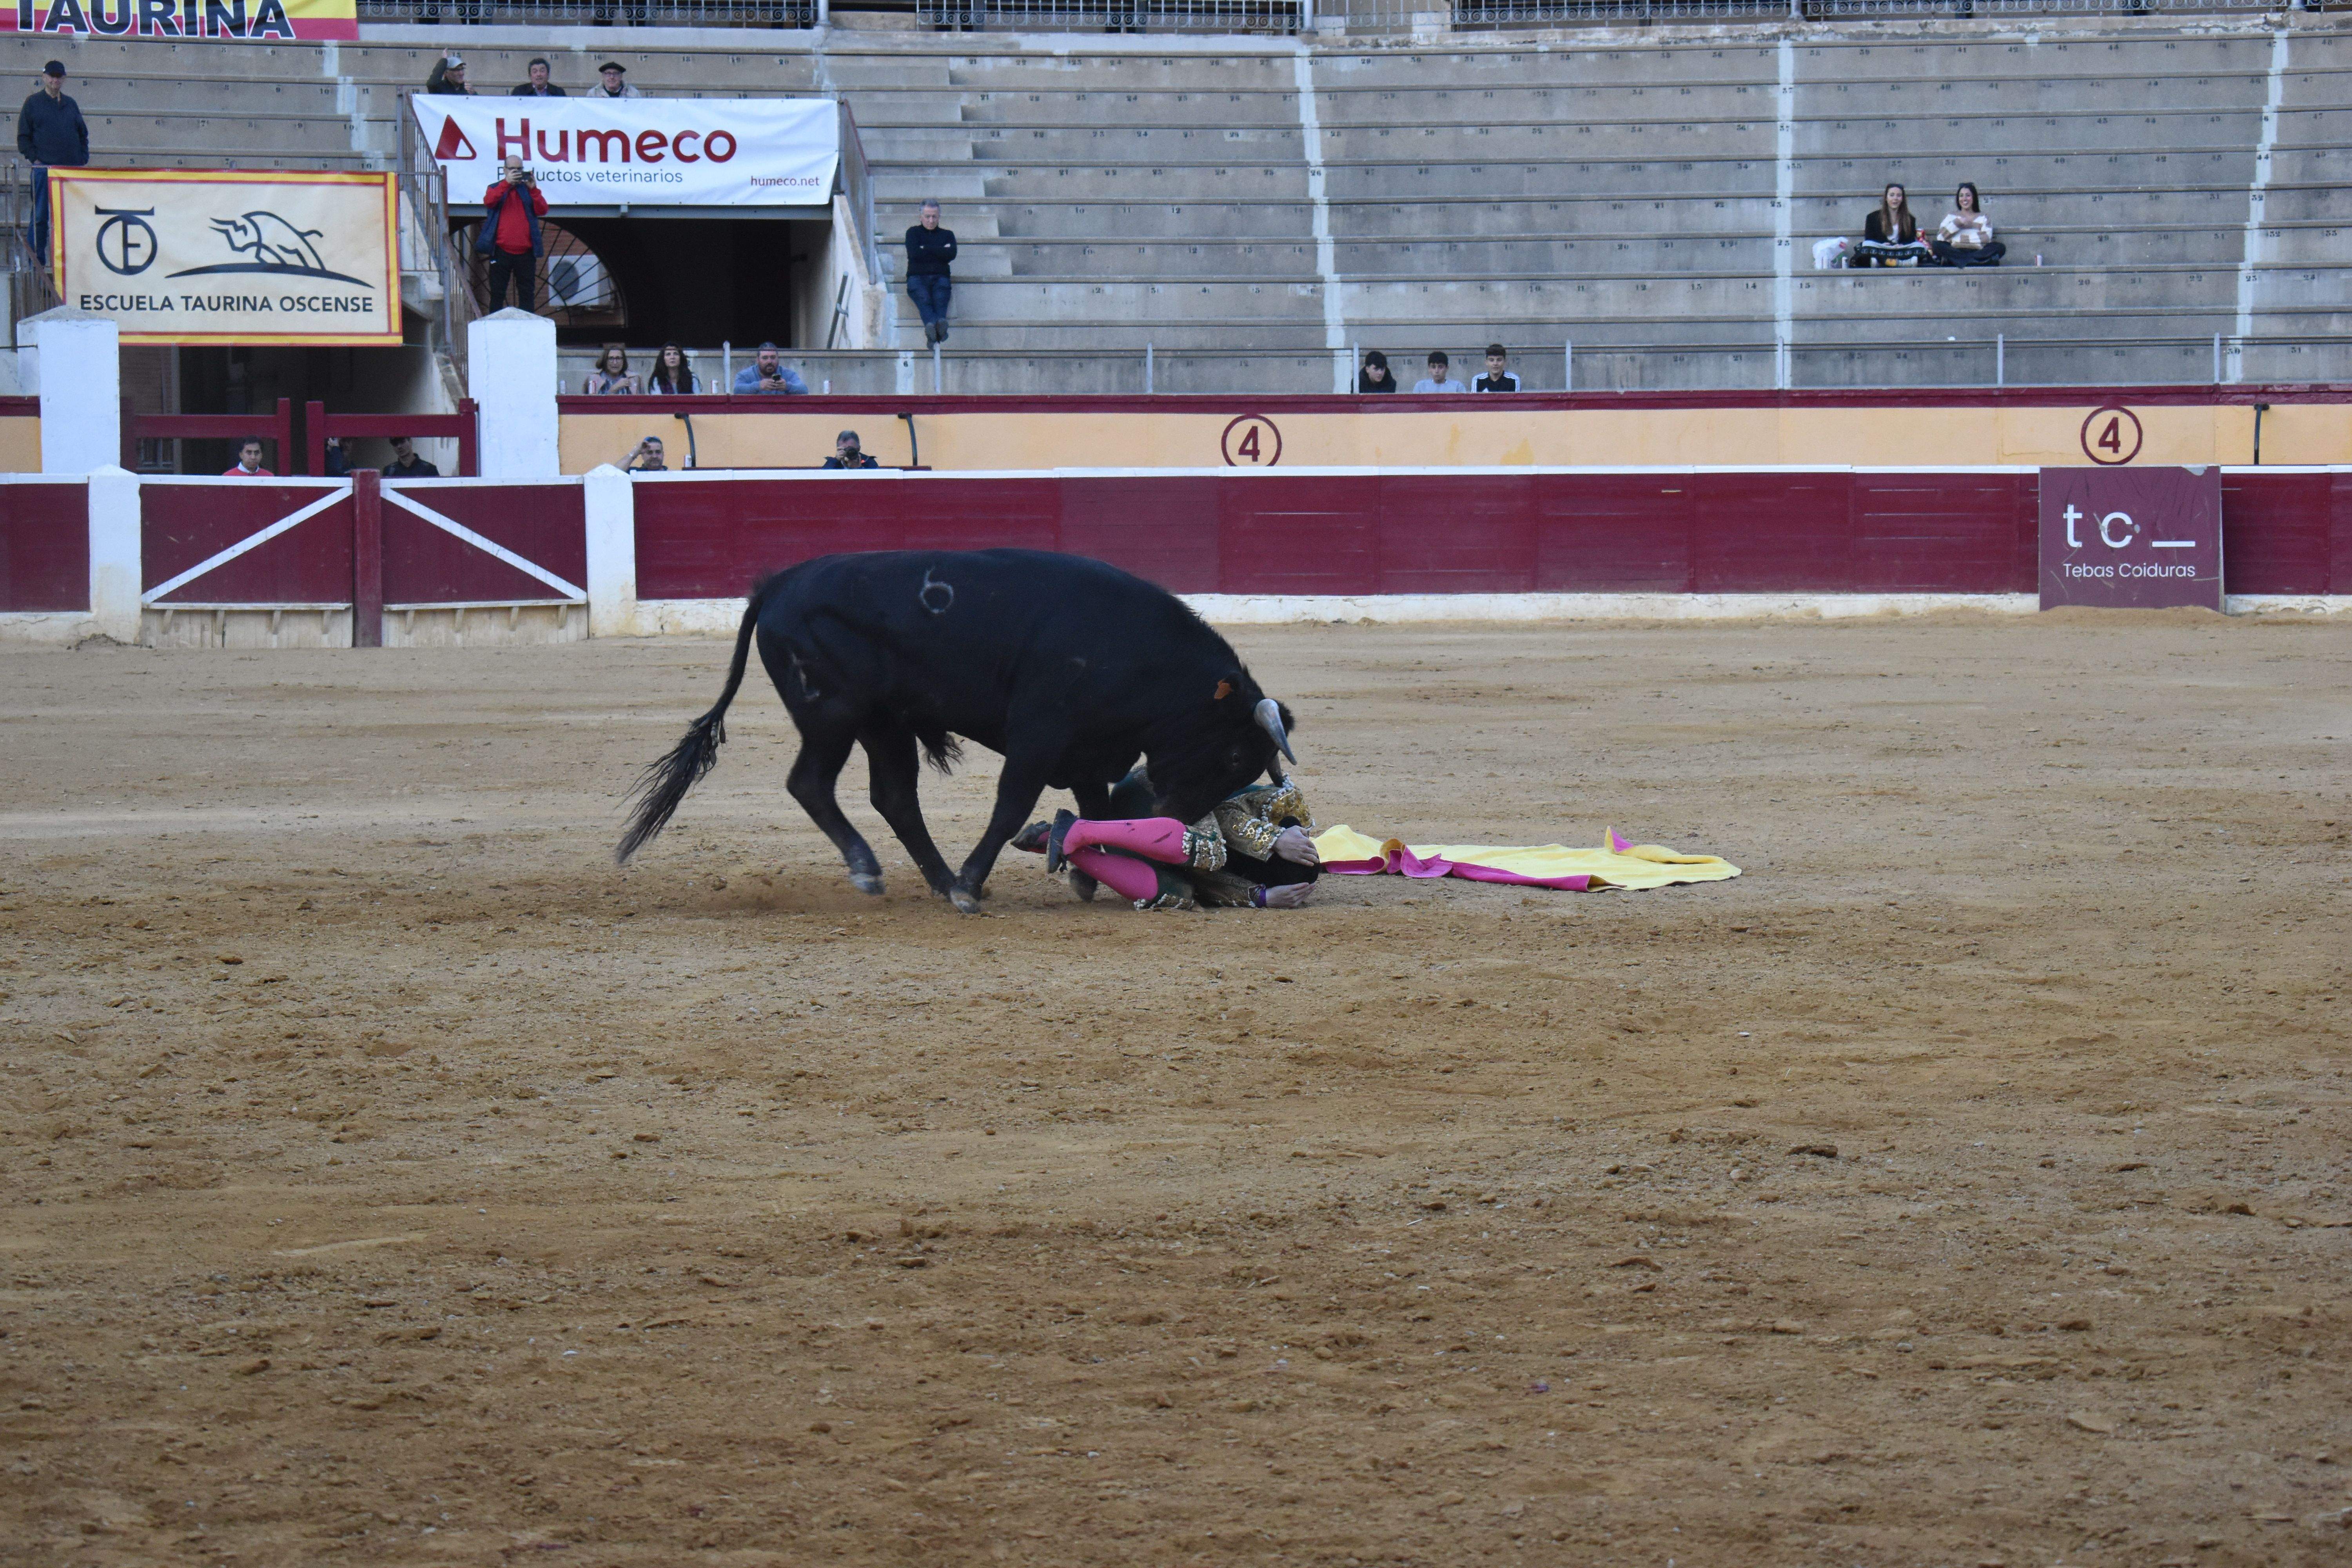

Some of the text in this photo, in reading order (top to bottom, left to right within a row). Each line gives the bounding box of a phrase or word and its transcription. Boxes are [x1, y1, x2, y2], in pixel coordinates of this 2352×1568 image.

[495, 118, 737, 164] Humeco
[586, 169, 682, 183] veterinarios
[750, 176, 819, 186] humeco.net
[80, 295, 373, 312] ESCUELA TAURINA OSCENSE
[1238, 425, 1260, 462] 4
[2098, 417, 2121, 454] 4
[2063, 563, 2195, 577] Tebas Coiduras
[919, 565, 954, 614] 6
